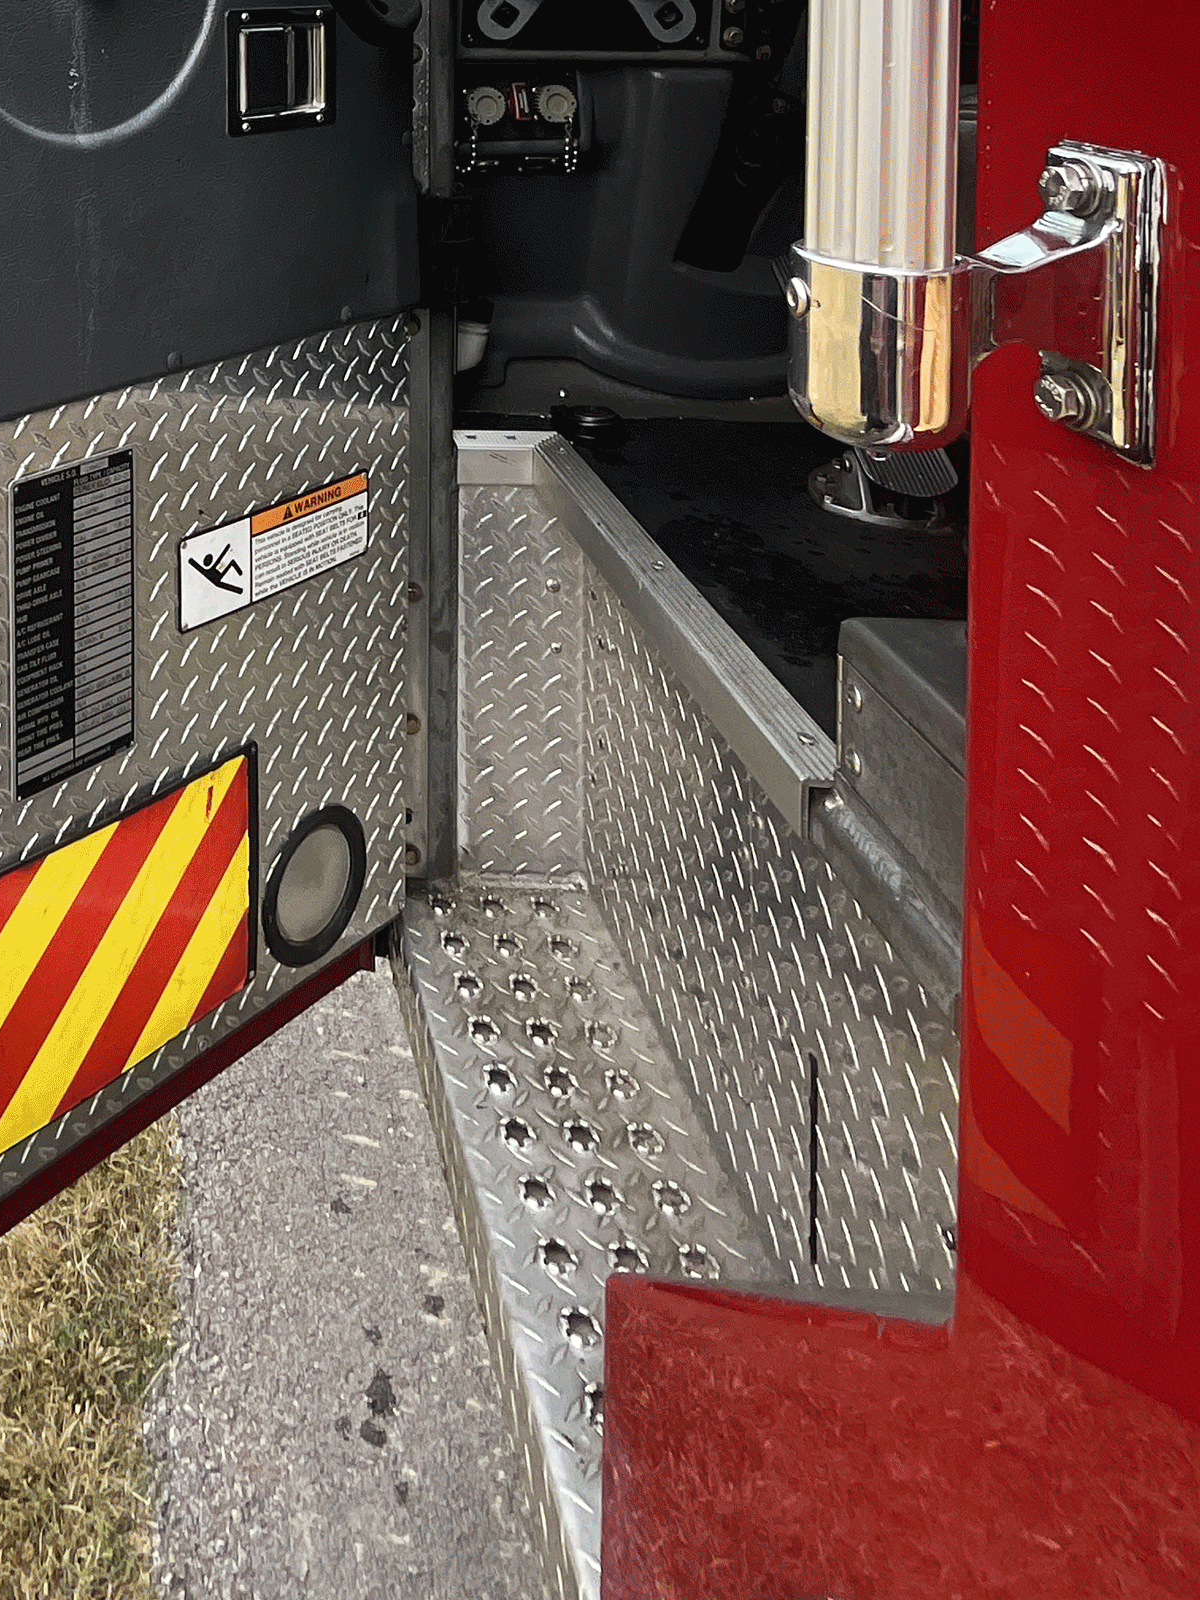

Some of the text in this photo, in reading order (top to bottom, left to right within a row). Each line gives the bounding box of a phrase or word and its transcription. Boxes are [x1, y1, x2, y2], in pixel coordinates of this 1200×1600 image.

[41, 472, 64, 487] VEHICLE
[107, 462, 130, 475] CAPACITY
[15, 501, 34, 514] ENGINE
[36, 492, 60, 507] COOLANT
[295, 487, 341, 514] WARNING
[15, 510, 44, 527] ENGINE OIL
[15, 519, 56, 539] TRANSMISSION
[255, 536, 265, 545] This
[267, 529, 285, 541] vehicle
[292, 517, 314, 531] designed
[323, 506, 342, 519] carrying
[292, 525, 312, 539] SEATED
[314, 515, 337, 530] POSITION
[16, 538, 34, 551] POWER
[255, 551, 273, 563] vehicle
[280, 538, 303, 553] equipped
[304, 533, 315, 542] with
[316, 527, 328, 537] SEAT
[330, 520, 345, 531] BELTS
[347, 515, 356, 524] FOR
[284, 545, 306, 560] Standing
[307, 540, 319, 549] while
[321, 532, 337, 543] vehicle
[16, 551, 35, 565] POWER
[36, 541, 62, 557] STEERING
[276, 568, 293, 579] seated
[294, 562, 305, 571] with
[306, 556, 318, 566] SEAT
[320, 548, 336, 560] BELTS
[337, 536, 363, 552] FASTENED
[288, 551, 310, 566] SERIOUS
[312, 543, 329, 555] INJURY
[331, 539, 339, 547] OR
[16, 565, 31, 577] PUMP
[16, 577, 32, 590] PUMP
[16, 584, 46, 602] DRIVE AXLE
[255, 587, 268, 597] while
[279, 572, 301, 586] VEHICLE
[49, 589, 62, 601] AXLE
[16, 627, 26, 637] A/C
[27, 612, 63, 633] REFRIGERANT
[17, 640, 26, 650] A/C
[42, 630, 50, 639] OIL
[17, 638, 59, 662] TRANSFER CASE
[17, 663, 28, 674] CAB
[17, 667, 47, 686] EQUIPMENT
[17, 674, 58, 699] GENERATOR OIL
[17, 690, 49, 710] GENERATOR
[50, 679, 73, 696] COOLANT
[28, 696, 64, 718] COMPRESSOR
[18, 733, 35, 747] FRONT
